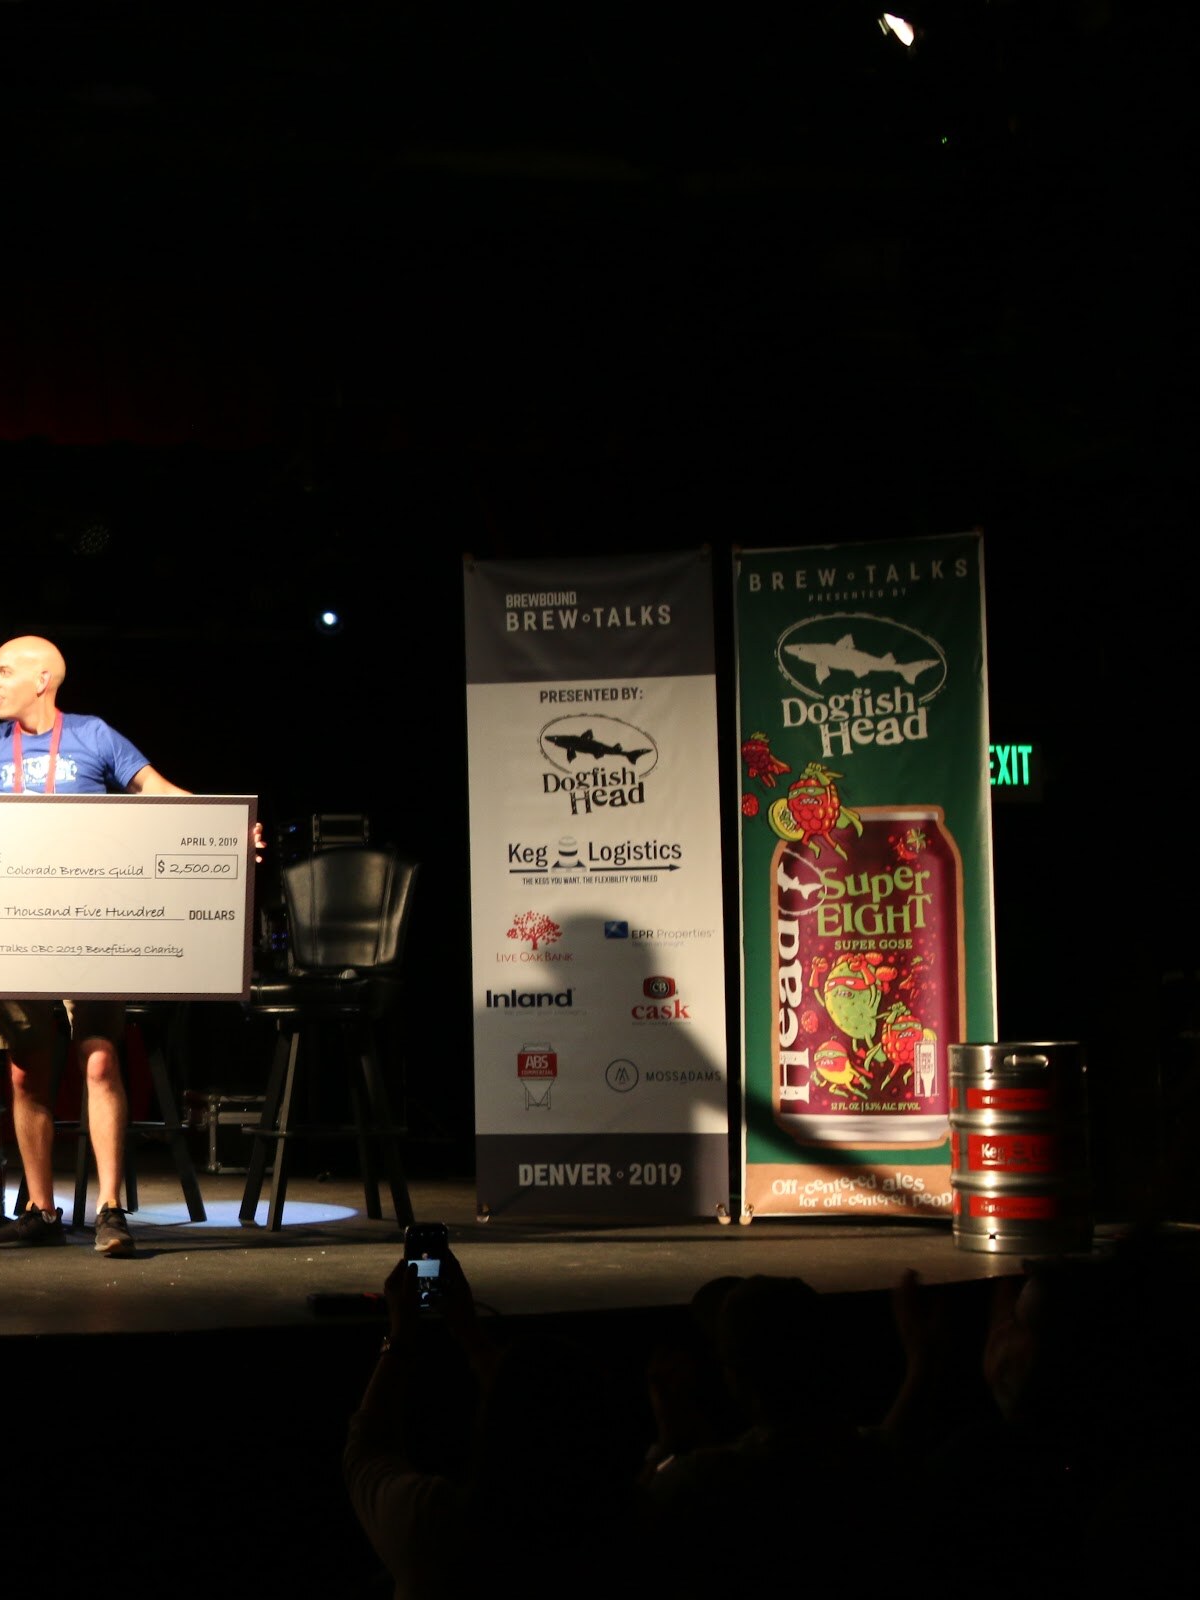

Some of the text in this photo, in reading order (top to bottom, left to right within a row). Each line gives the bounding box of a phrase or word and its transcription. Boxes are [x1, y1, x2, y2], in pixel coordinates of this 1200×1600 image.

[749, 558, 968, 592] BREW TALKS
[505, 591, 577, 608] BREWBOUND
[506, 604, 671, 632] BREW TALKS
[540, 686, 643, 703] PRESENTED BY:
[781, 686, 916, 728] Dogfish
[819, 707, 928, 758] Head
[542, 766, 637, 794] Dogfish
[569, 782, 645, 815] Head
[180, 837, 238, 847] APRIL 9, 2019
[508, 840, 682, 867] Keg Logistics
[7, 859, 230, 878] Colorado Brewers Guild $ 2,500.00
[535, 877, 550, 885] KEGS
[583, 876, 593, 884] THE
[594, 876, 629, 884] FLEXIBILITY
[630, 875, 642, 883] YOU
[818, 866, 931, 903] Super
[4, 906, 71, 916] Thousand
[74, 904, 101, 917] Five
[105, 906, 165, 917] Hundred
[189, 910, 235, 921] DOLLARS
[817, 893, 932, 937] EIGHT
[631, 928, 711, 939] EPR Properties
[0, 945, 28, 953] Talks
[31, 945, 54, 953] CBC
[56, 945, 82, 955] 2019
[86, 944, 141, 956] Benefiting
[143, 944, 184, 957] Charity
[834, 939, 913, 950] SUPER GOSE
[486, 988, 572, 1008] Inland
[631, 999, 691, 1020] cask
[525, 1055, 549, 1069] ABS
[646, 1070, 722, 1082] MOSSADAMS
[518, 1163, 682, 1186] DENVER 2019
[772, 1172, 925, 1195] Off-centered ales
[799, 1193, 819, 1207] for
[823, 1192, 906, 1207] off-centered
